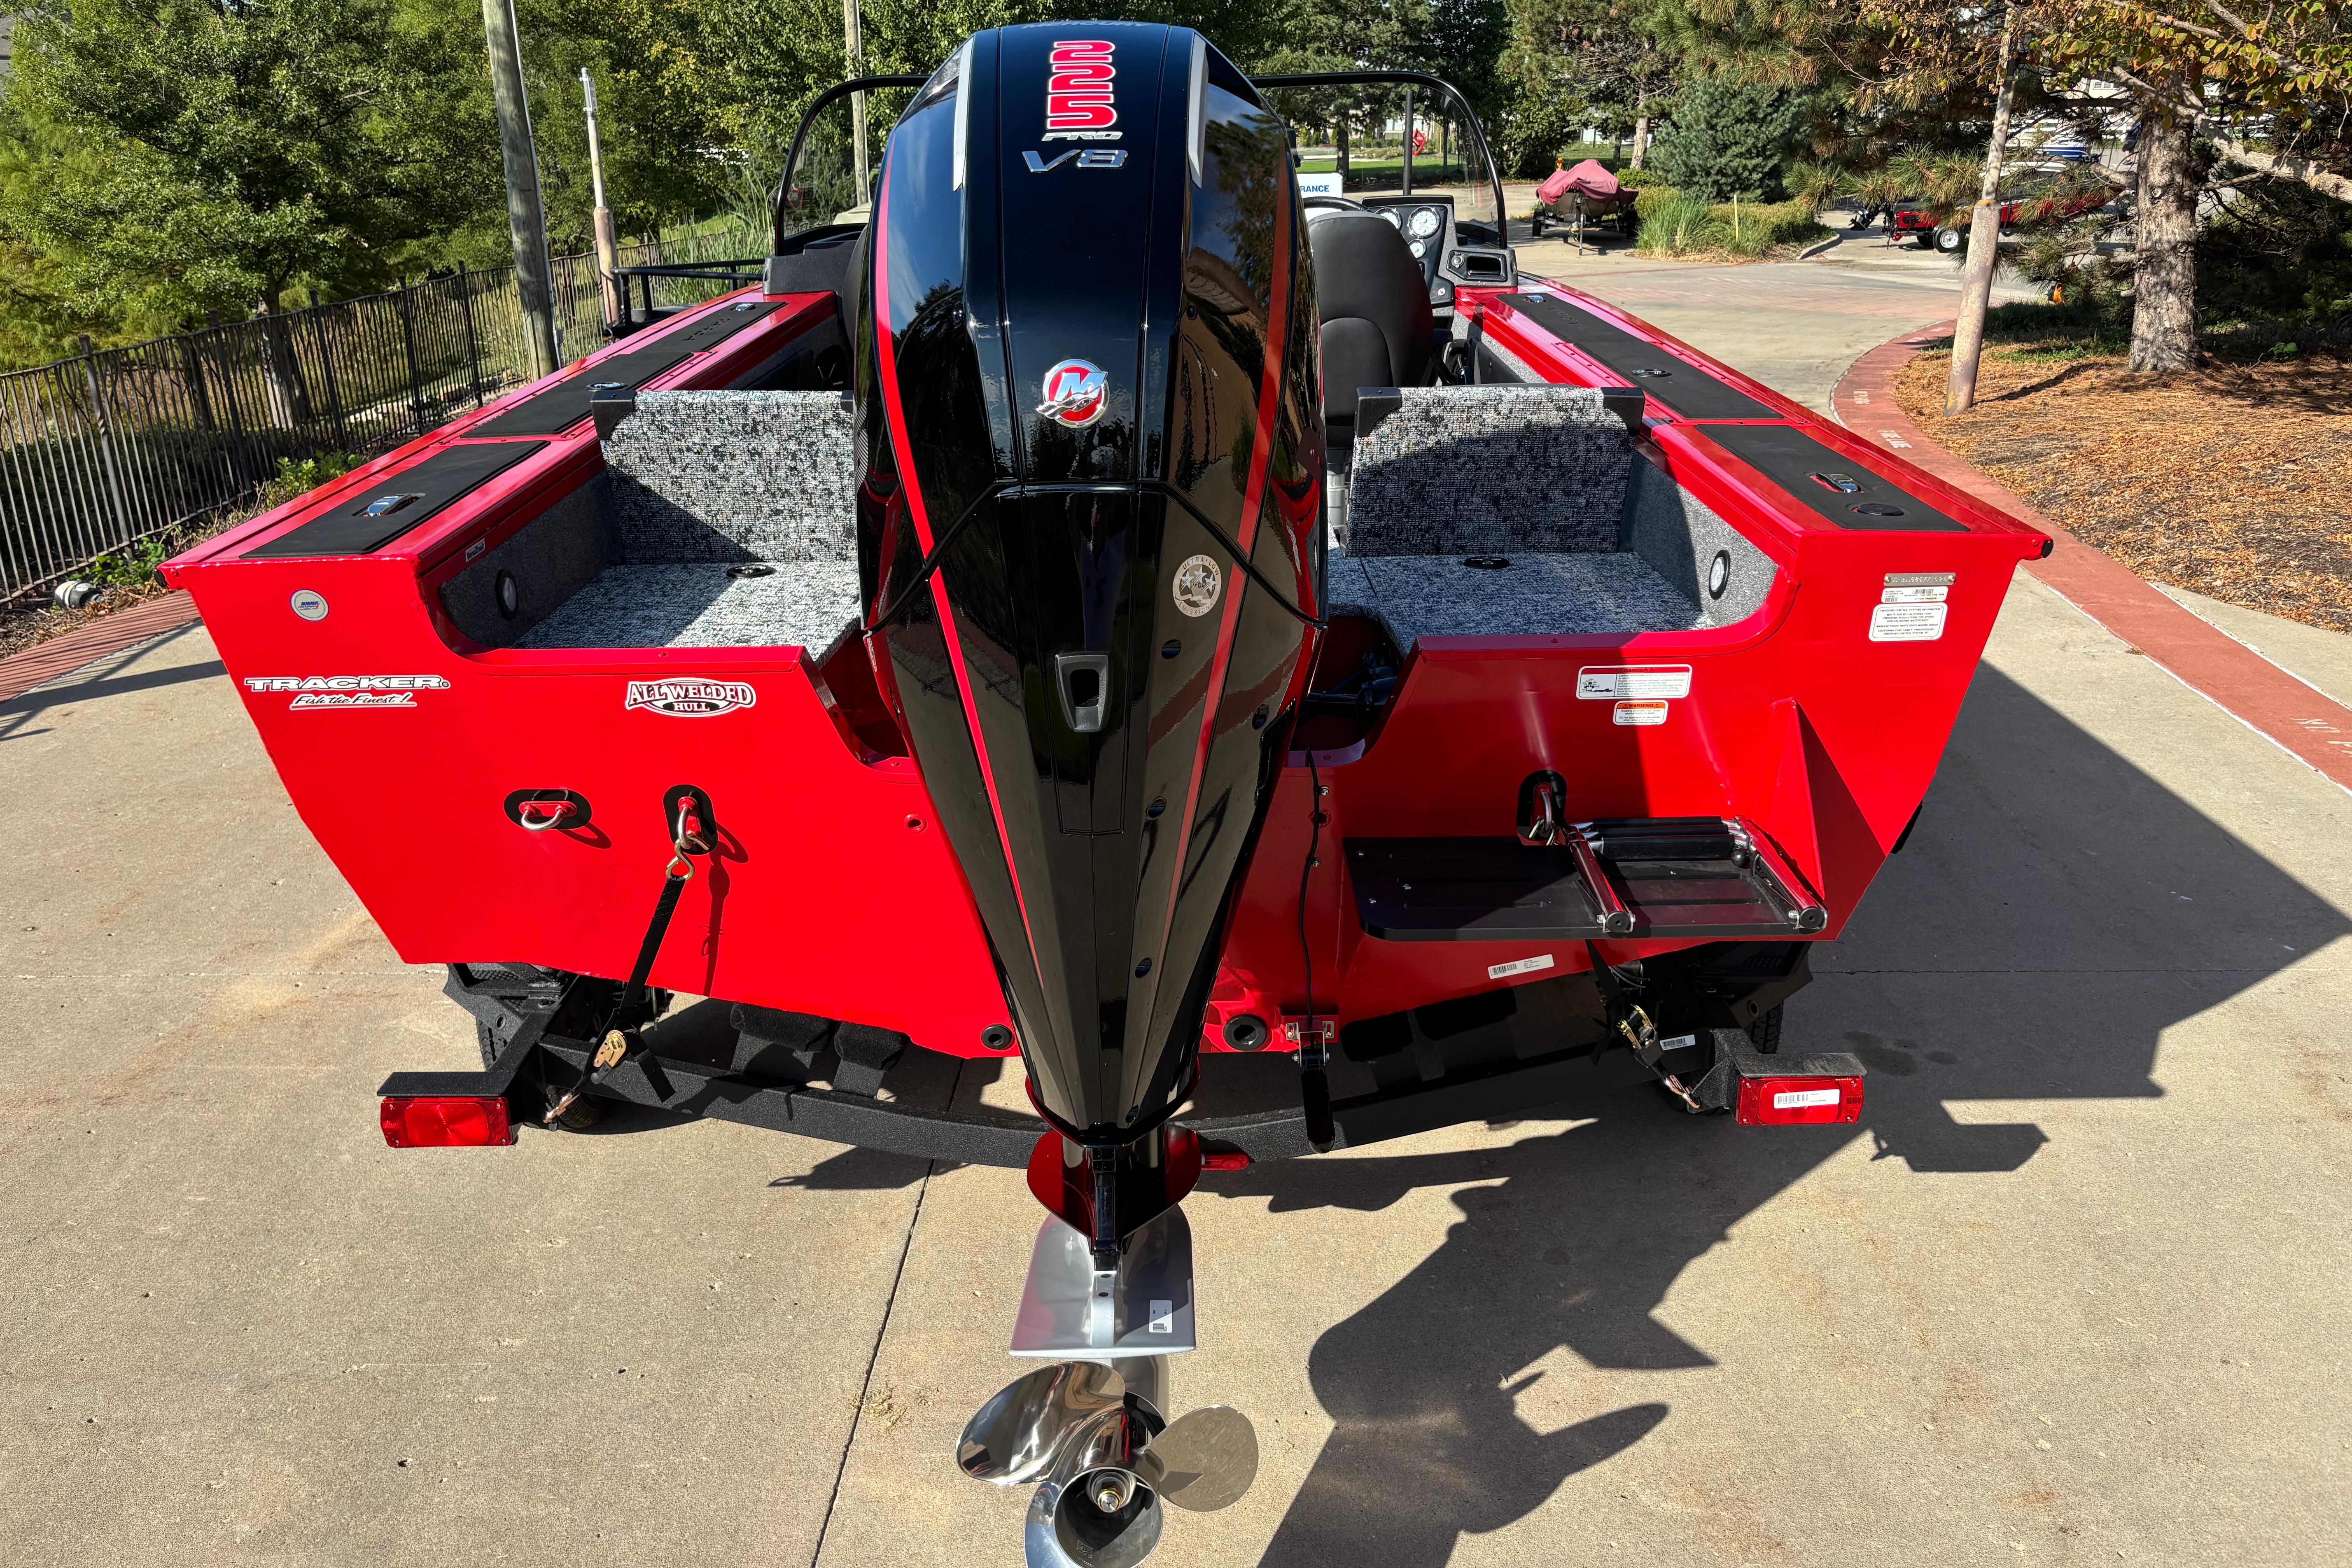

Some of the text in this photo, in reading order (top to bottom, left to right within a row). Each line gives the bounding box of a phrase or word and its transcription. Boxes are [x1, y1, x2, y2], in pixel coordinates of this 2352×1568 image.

[1046, 40, 1117, 129] 225
[1042, 131, 1123, 141] PRO
[1022, 149, 1128, 172] V8
[246, 677, 441, 691] TRACKER
[295, 696, 326, 704] Fish
[629, 684, 754, 705] ALL WELDED
[672, 702, 710, 711] HULL
